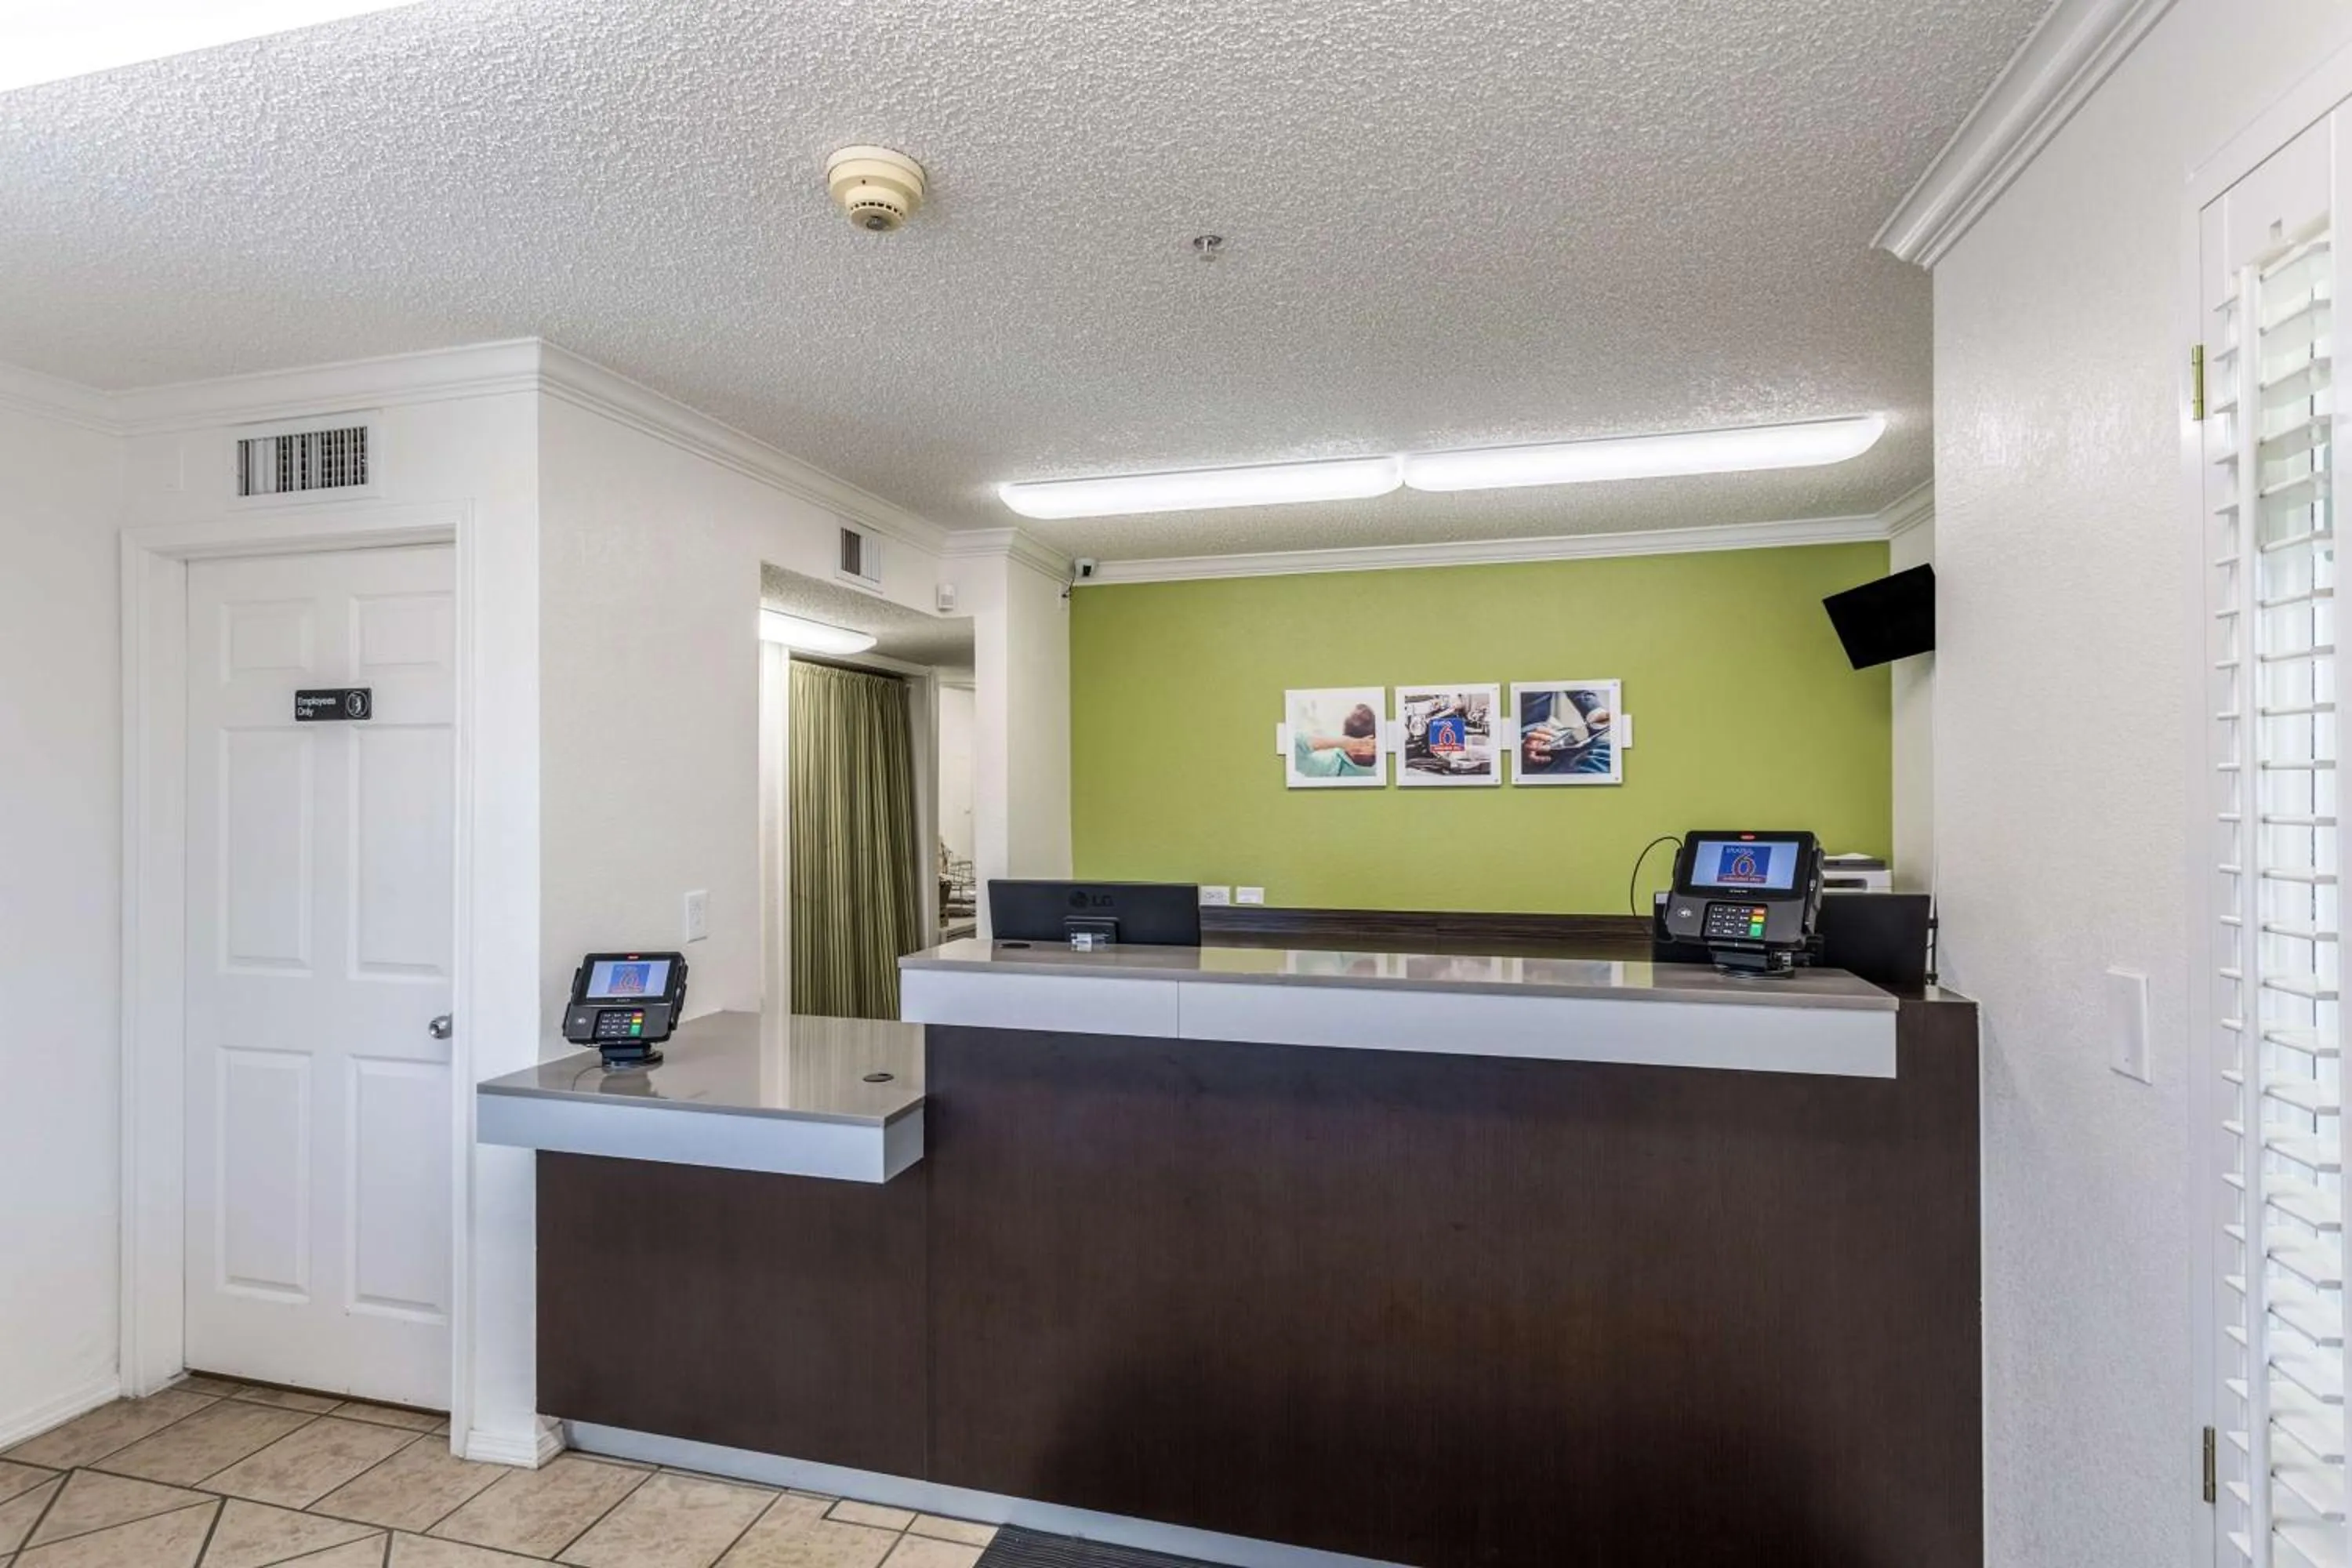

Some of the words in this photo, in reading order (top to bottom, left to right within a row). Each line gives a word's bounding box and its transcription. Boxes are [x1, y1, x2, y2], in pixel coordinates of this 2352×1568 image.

[297, 696, 336, 706] Employees
[297, 706, 314, 717] Only
[1439, 724, 1456, 746] 6
[1091, 894, 1115, 906] LG
